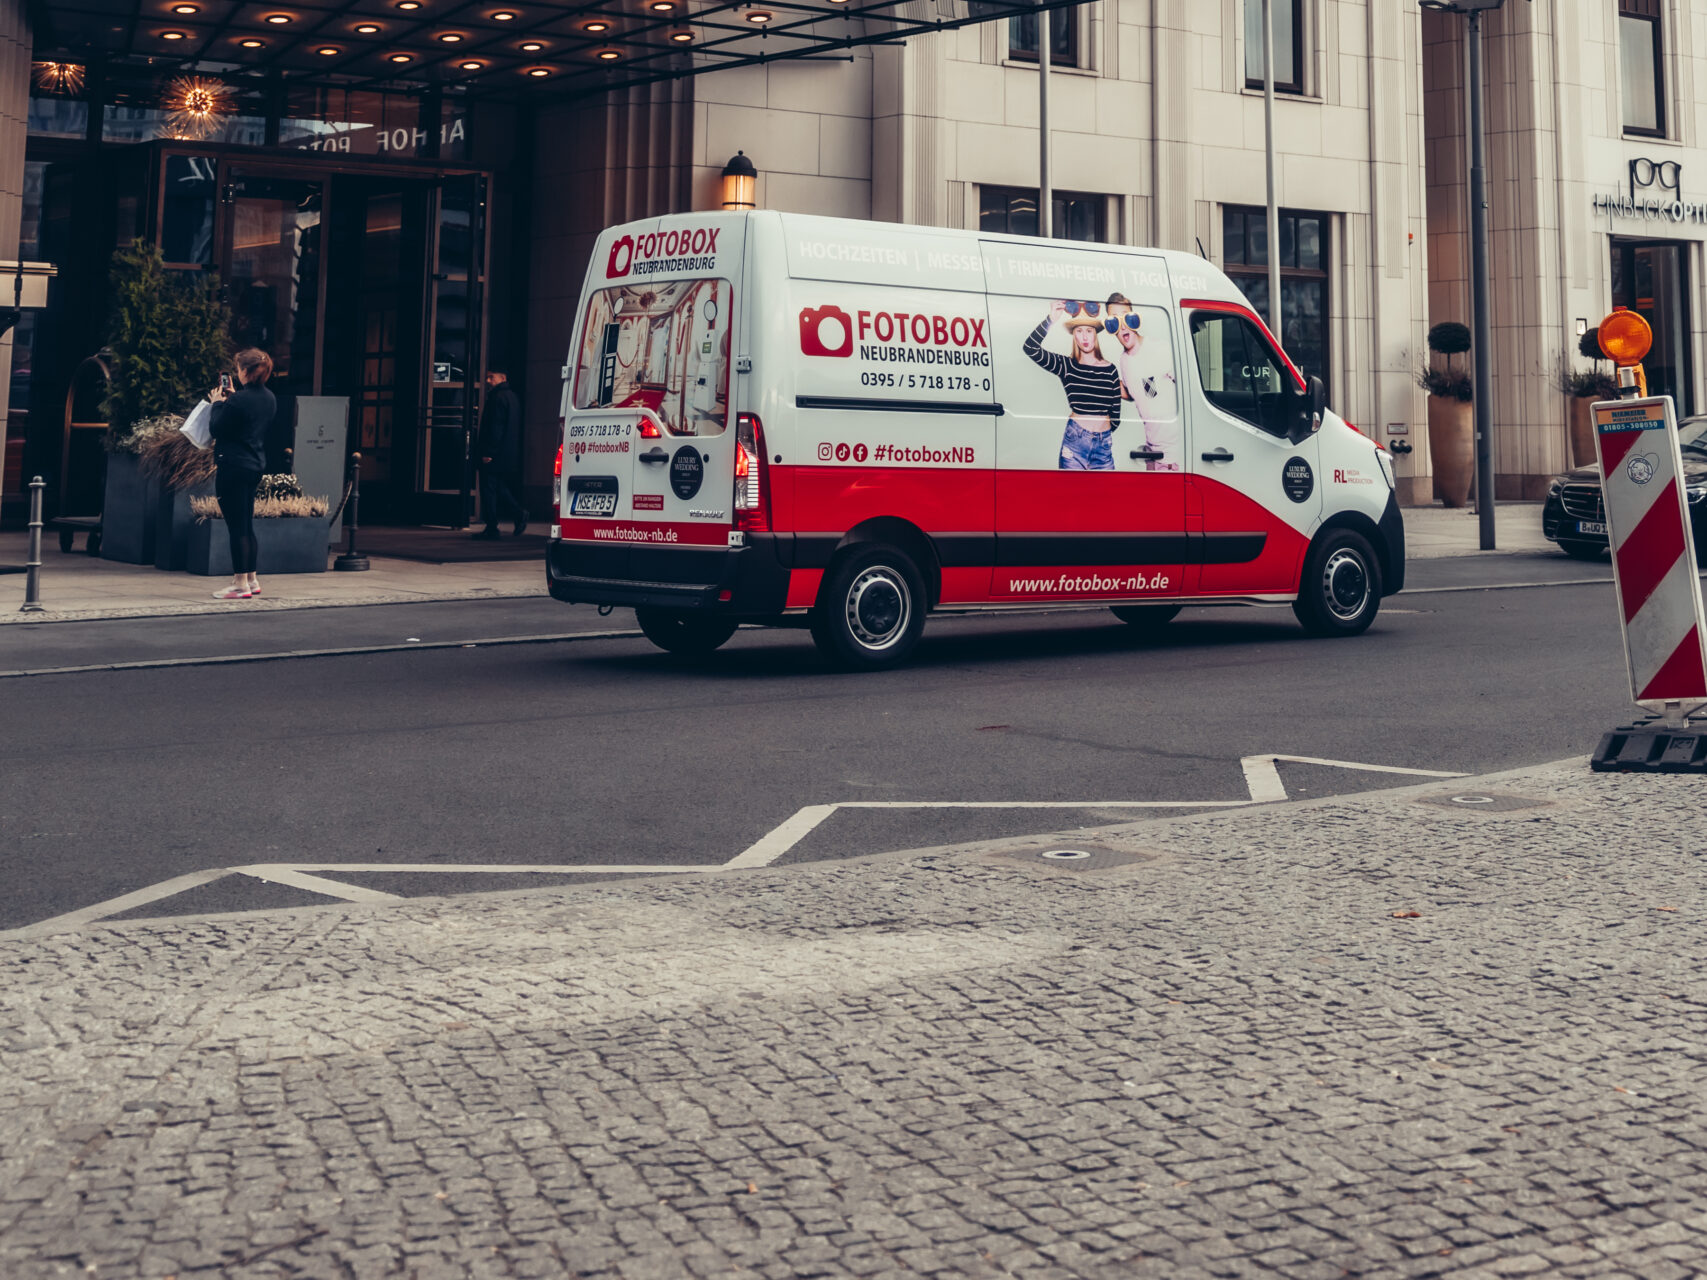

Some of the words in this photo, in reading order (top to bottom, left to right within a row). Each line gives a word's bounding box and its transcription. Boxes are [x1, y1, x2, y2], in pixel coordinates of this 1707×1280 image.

[1671, 200, 1707, 223] OPTI
[635, 228, 720, 260] FOTOBOX
[632, 256, 715, 275] NEUBRANDENBURG
[800, 241, 909, 266] HOCHZEITEN
[927, 251, 991, 274] MESSEN
[1008, 259, 1115, 284] FIRMENFEIERN
[1131, 271, 1208, 292] TAGUNGEN
[857, 310, 988, 348] FOTOBOX
[860, 345, 990, 367] NEUBRANDENBURG
[861, 372, 895, 387] 0395
[919, 375, 944, 389] 718
[947, 377, 971, 390] 178
[570, 425, 585, 437] 0395
[587, 441, 629, 453] #fotoboxNB
[874, 444, 975, 463] #fotoboxNB
[1333, 469, 1347, 483] RL
[593, 526, 678, 542] www.fotobox-nb.de
[1010, 572, 1169, 592] www.fotobox-nb.de
